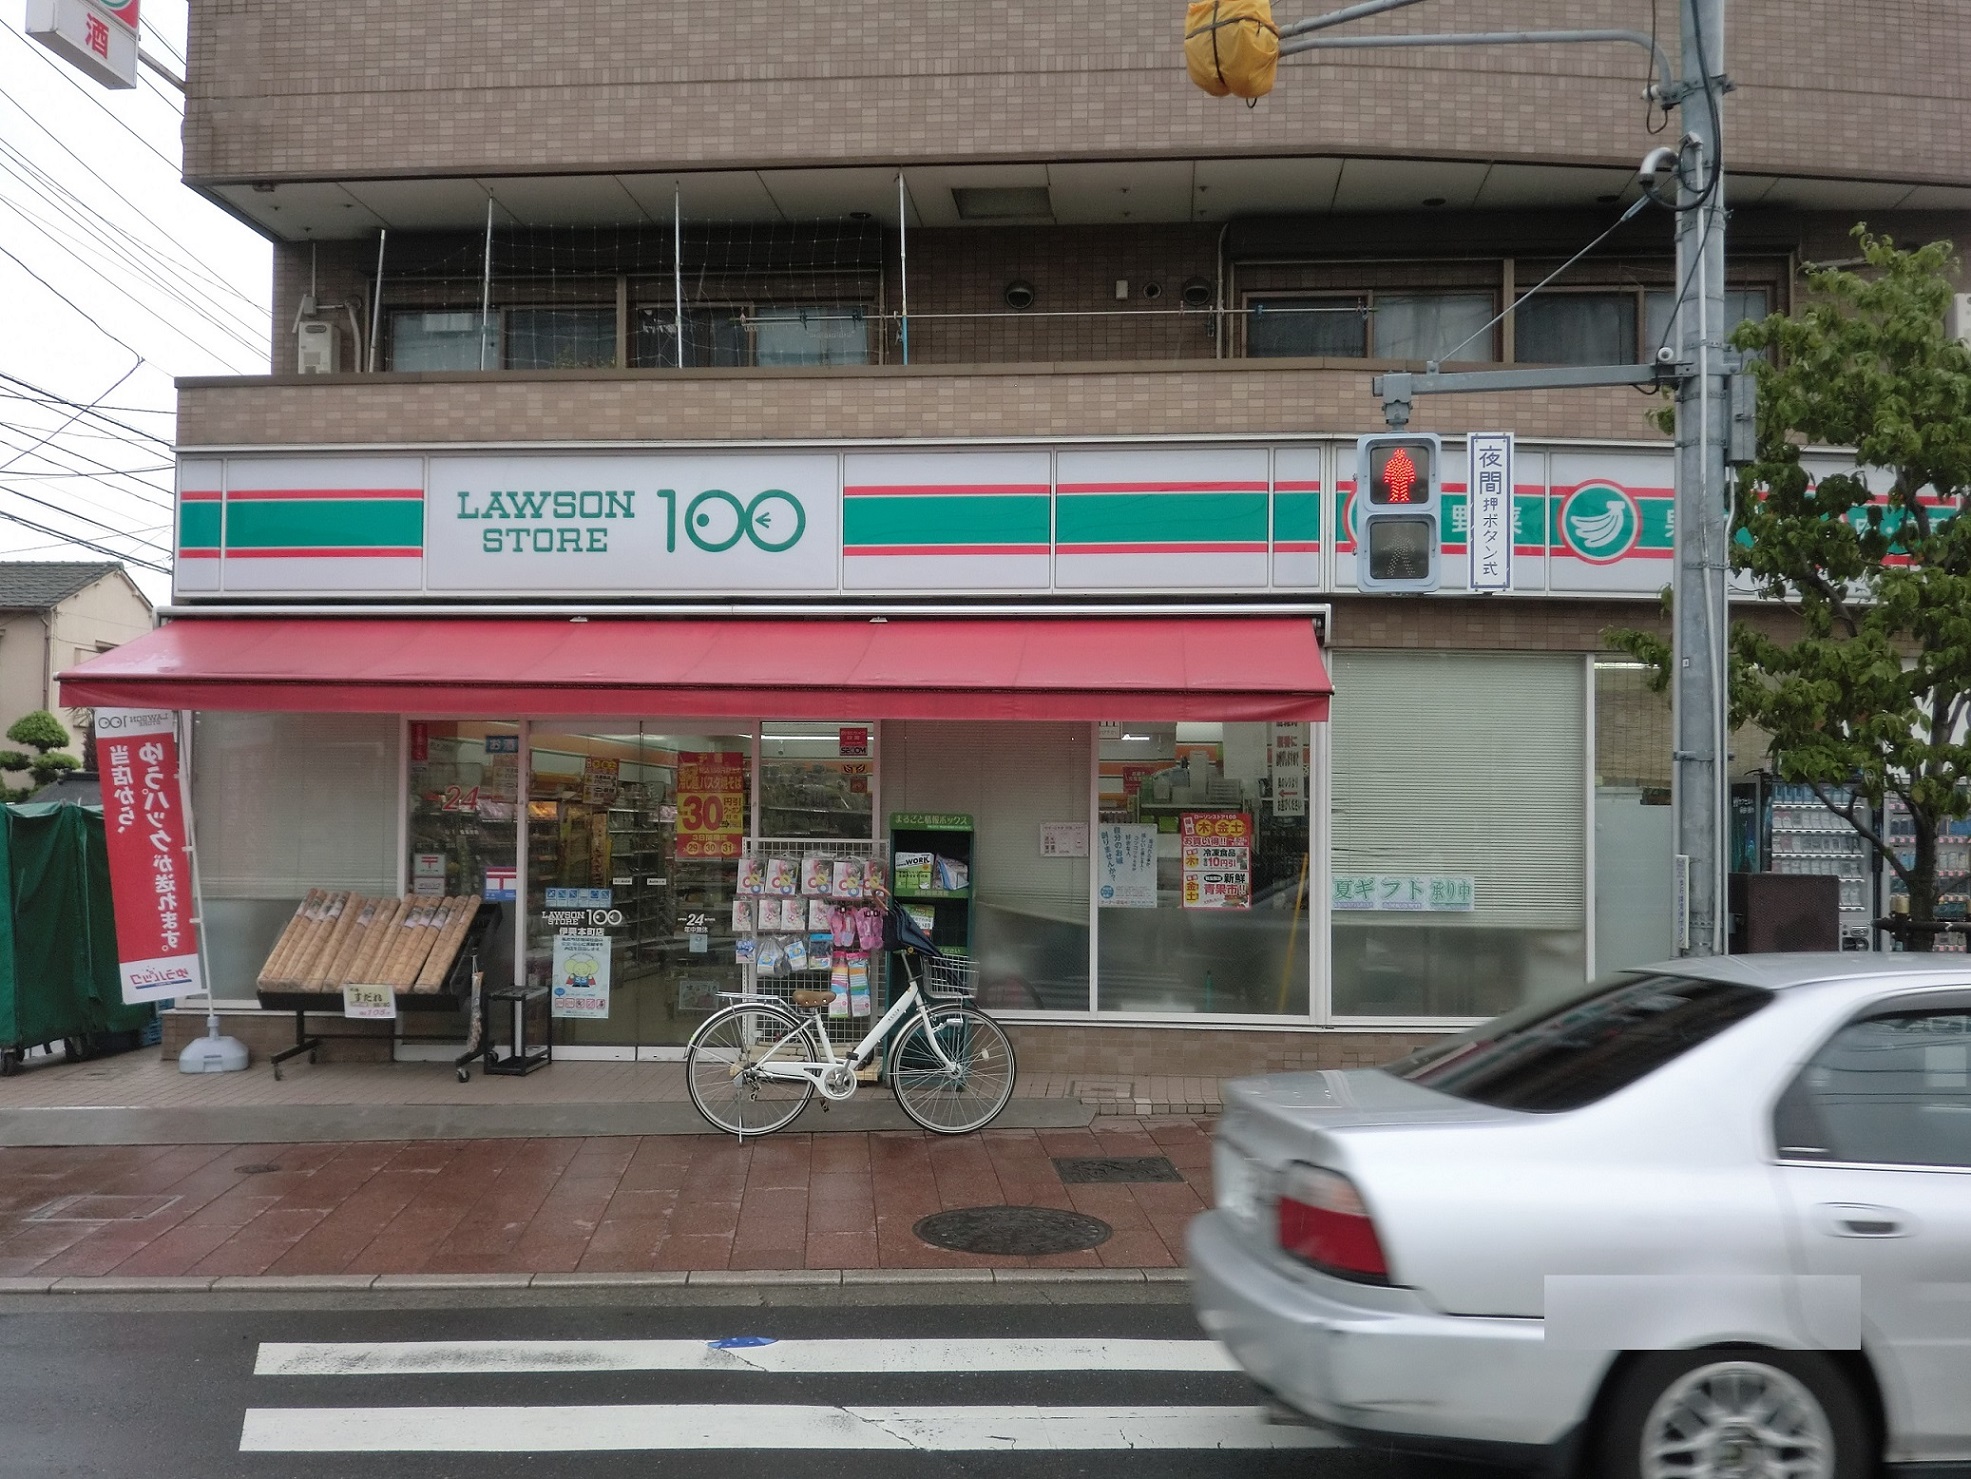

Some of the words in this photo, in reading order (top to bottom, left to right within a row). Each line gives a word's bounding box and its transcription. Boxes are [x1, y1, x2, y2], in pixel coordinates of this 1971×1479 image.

[85, 12, 109, 59] 酒
[457, 491, 635, 519] LAWSON
[657, 489, 806, 553] 100
[483, 528, 608, 552] STORE
[442, 785, 481, 812] 24
[683, 795, 723, 831] 30
[1223, 873, 1246, 884] 新鮮
[541, 911, 585, 920] LAWSON
[586, 909, 623, 926] 100
[686, 913, 705, 926] 24
